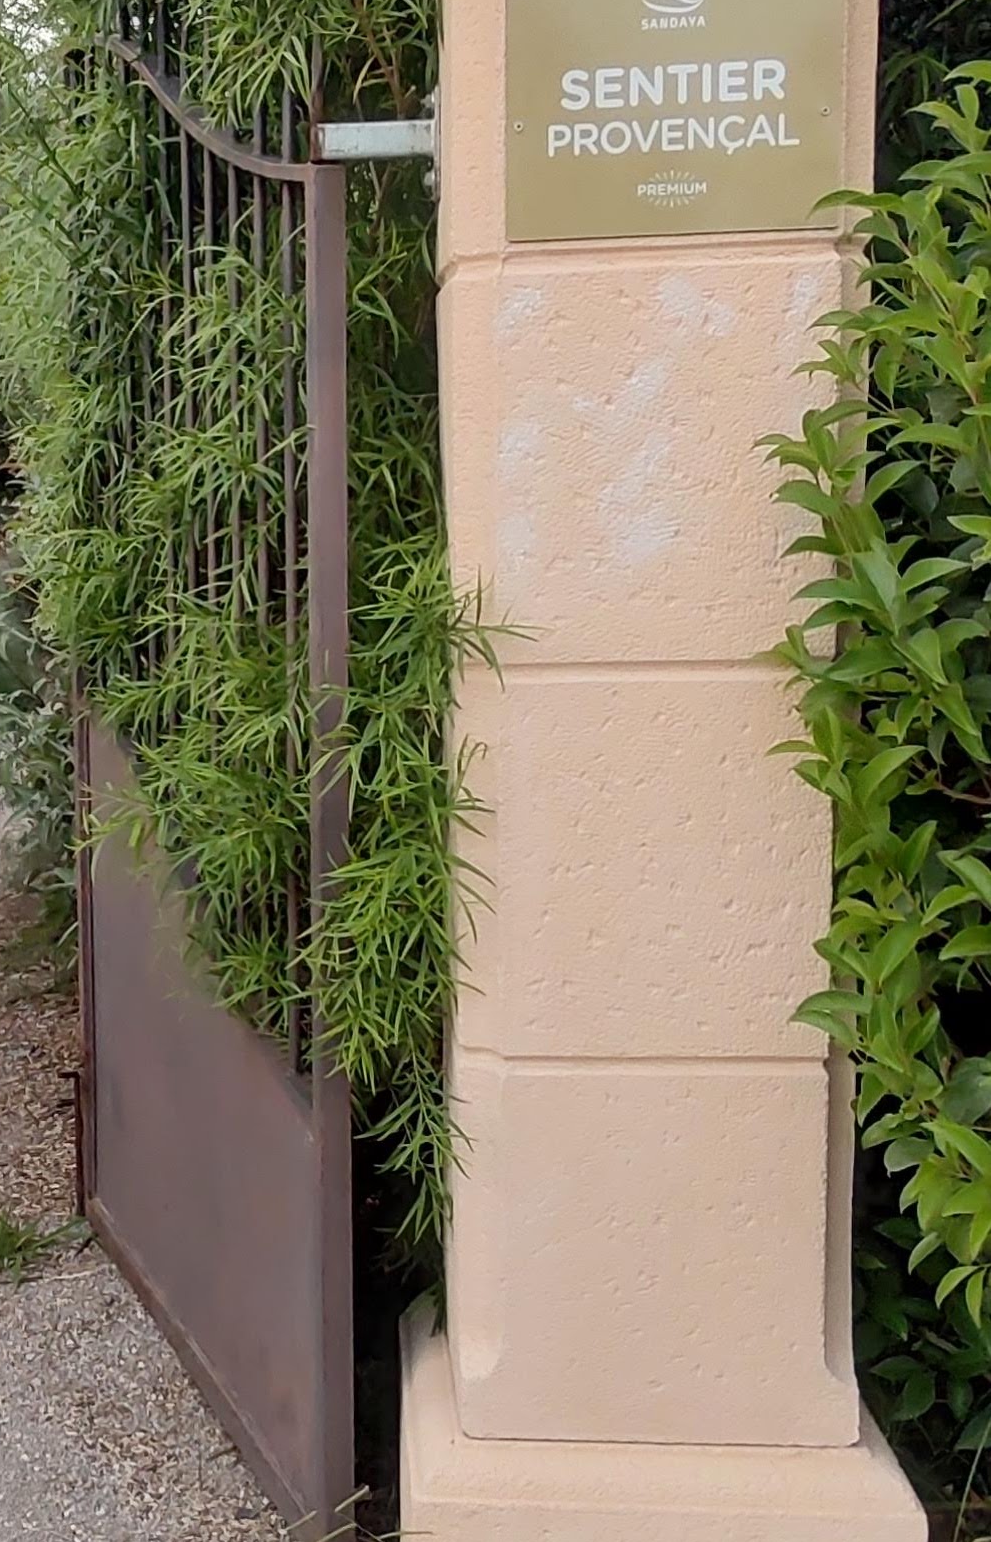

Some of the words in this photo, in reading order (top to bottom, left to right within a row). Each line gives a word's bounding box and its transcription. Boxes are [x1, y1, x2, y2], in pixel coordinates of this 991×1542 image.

[640, 15, 706, 31] SANDAYA
[560, 59, 786, 111] SENTIER
[547, 112, 801, 158] PROVENÇAL
[636, 181, 707, 197] PREMIUM
